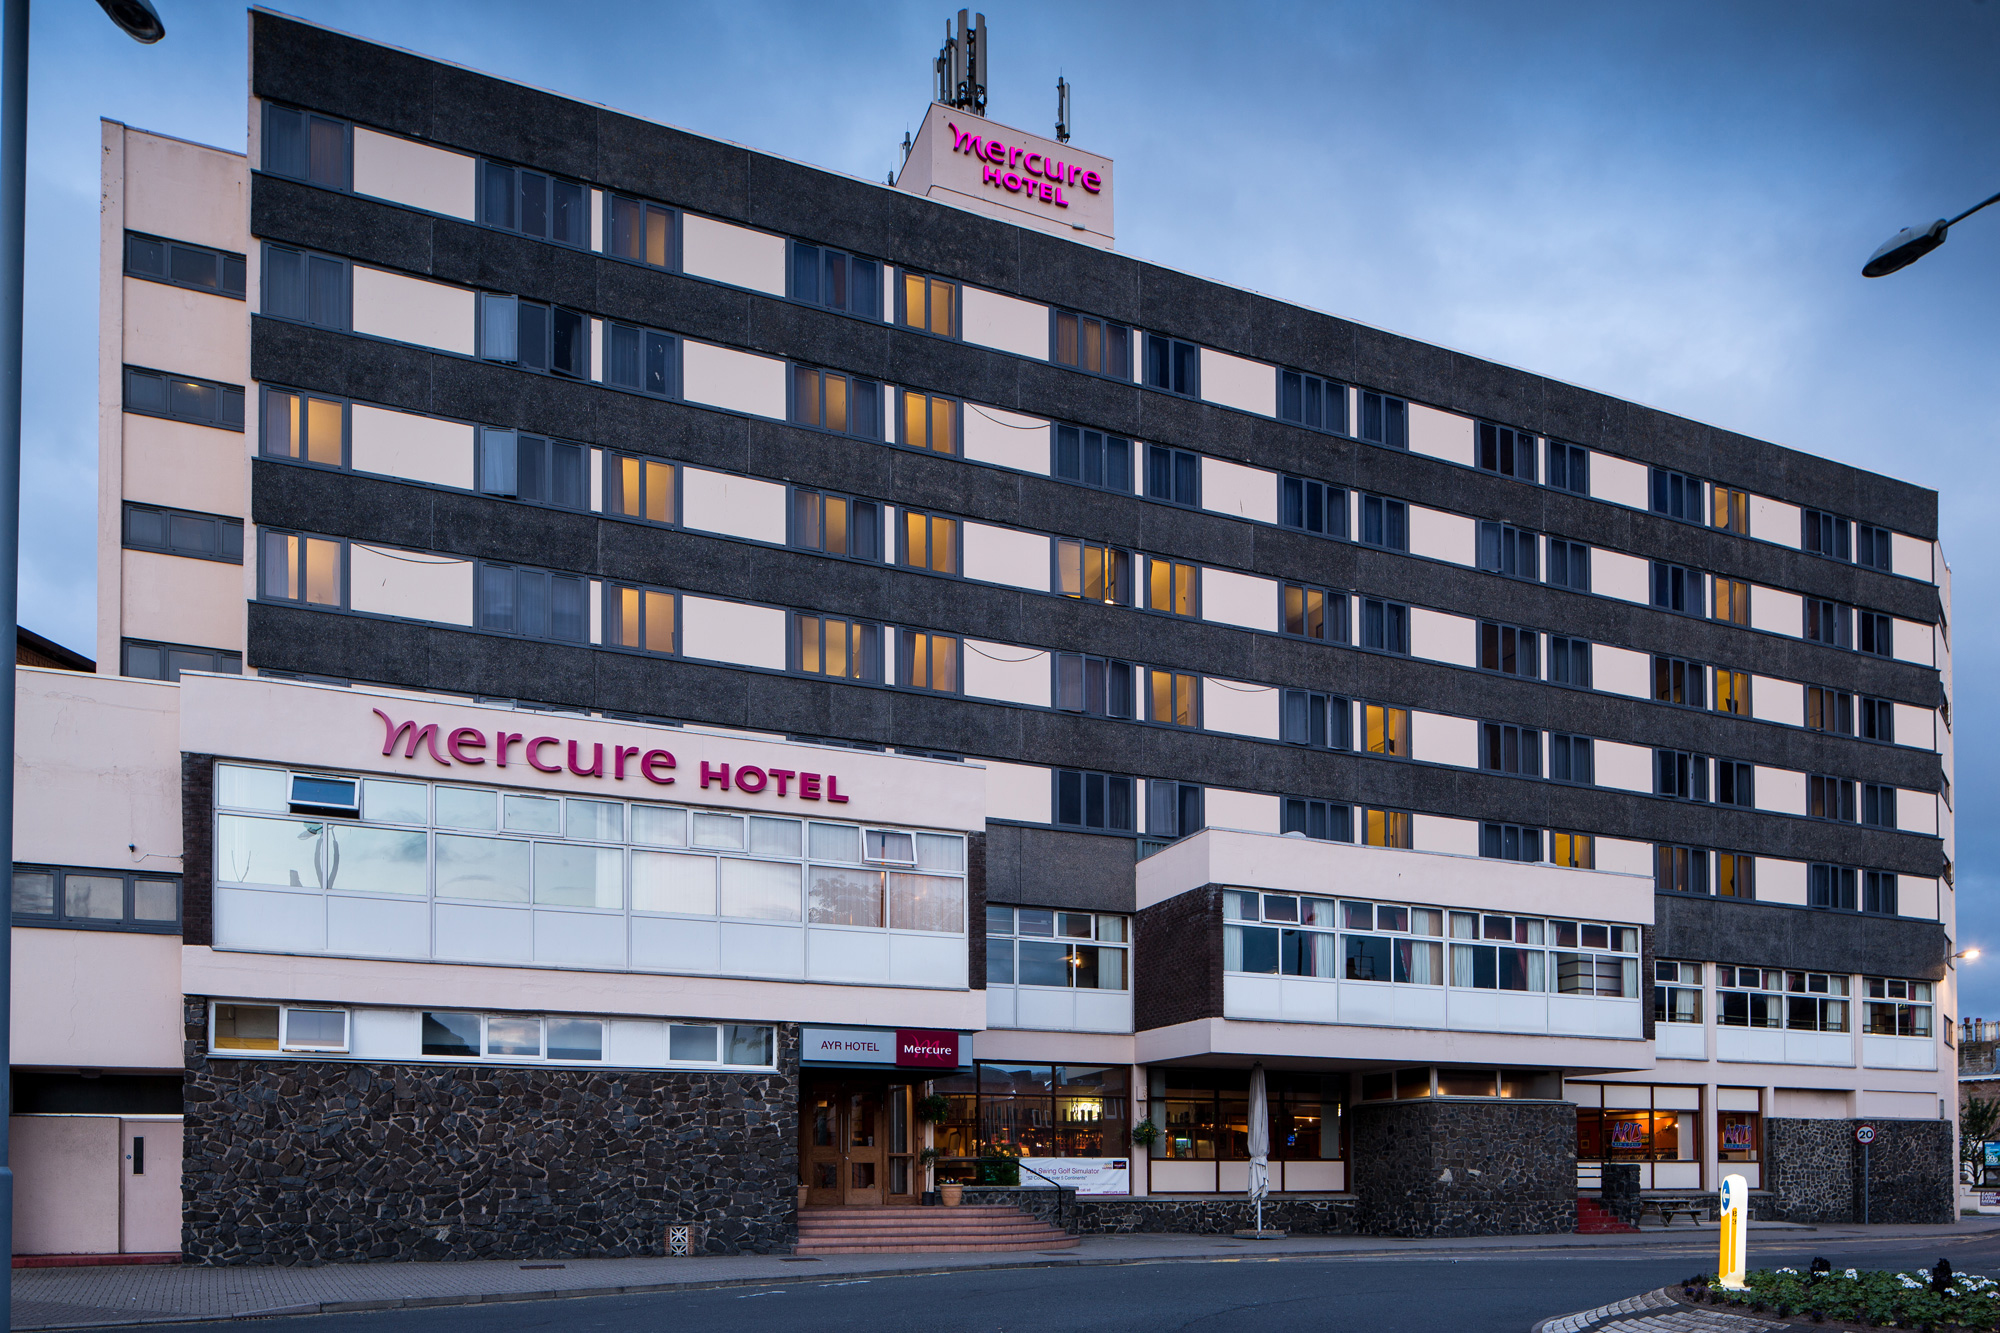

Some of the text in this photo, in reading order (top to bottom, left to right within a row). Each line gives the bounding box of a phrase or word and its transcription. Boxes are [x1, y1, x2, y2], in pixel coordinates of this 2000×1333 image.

[983, 165, 1069, 208] HOTEL
[700, 760, 849, 803] HOTEL
[821, 1040, 879, 1052] AYR HOTEL
[904, 1044, 952, 1055] Mercure
[1612, 1121, 1643, 1142] ARTS
[1724, 1124, 1752, 1144] ARTS
[1859, 1130, 1873, 1139] 20
[1038, 1167, 1056, 1175] Swing
